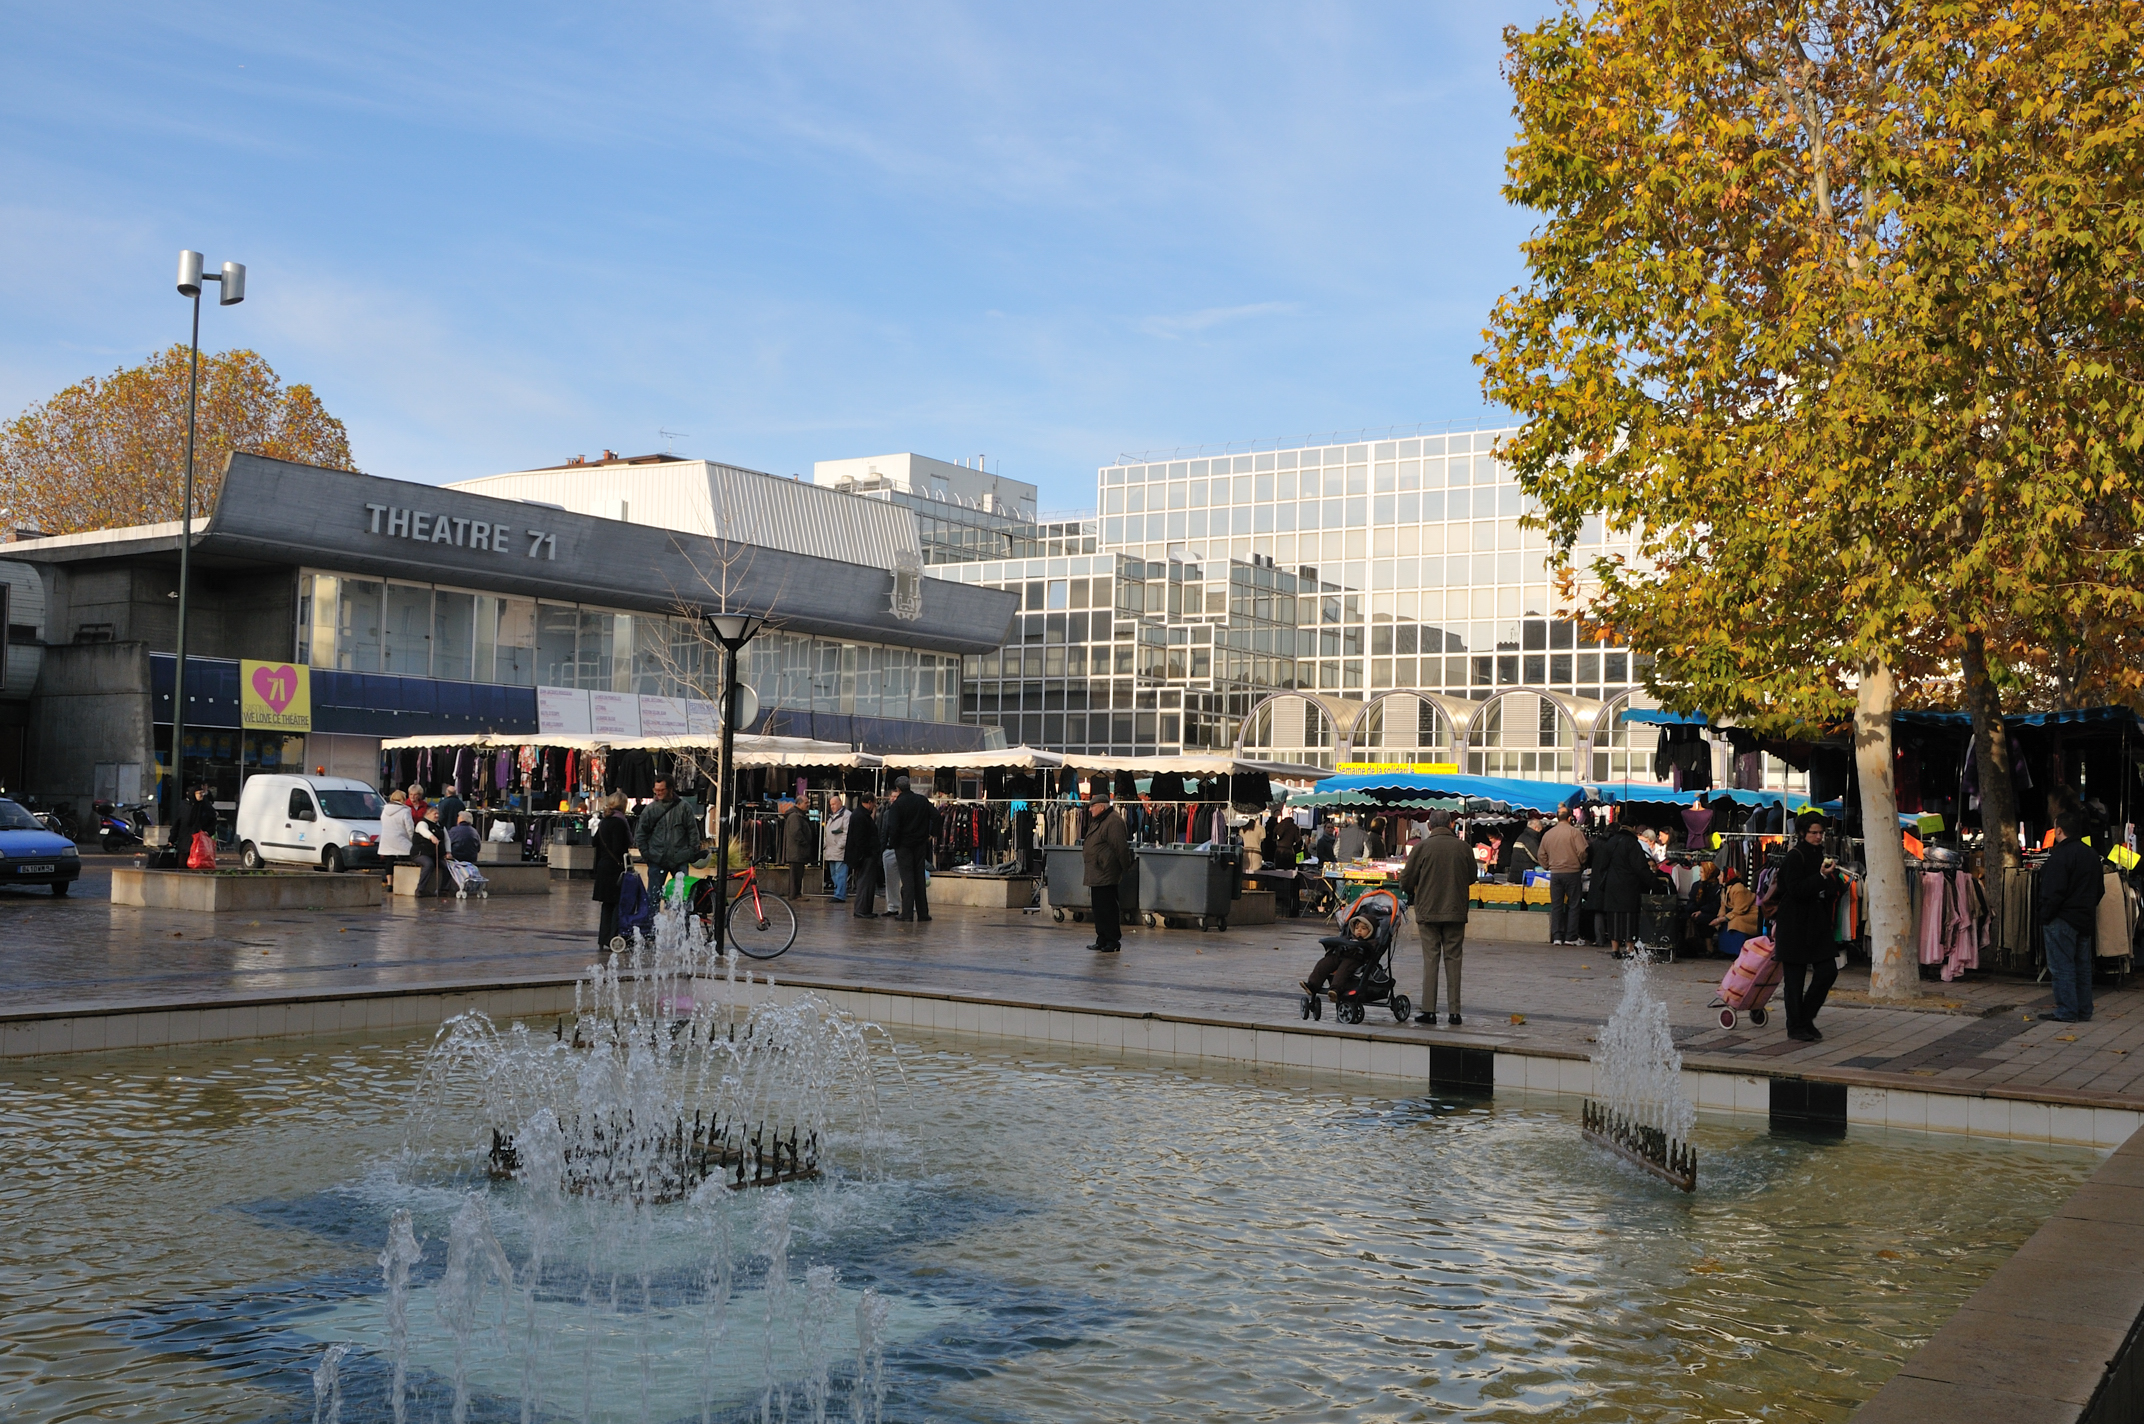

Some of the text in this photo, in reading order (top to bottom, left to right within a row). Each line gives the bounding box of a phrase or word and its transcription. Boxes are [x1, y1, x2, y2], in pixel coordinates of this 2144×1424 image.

[365, 503, 557, 561] THEATRE 71
[267, 677, 285, 702] 71
[243, 712, 255, 723] WE
[255, 713, 272, 724] LOVE
[272, 713, 281, 724] CE
[281, 712, 310, 726] THÉÂTRE
[1338, 764, 1366, 775] Semaine
[1366, 764, 1376, 775] de
[1376, 764, 1383, 775] la
[1383, 764, 1415, 775] solidarié
